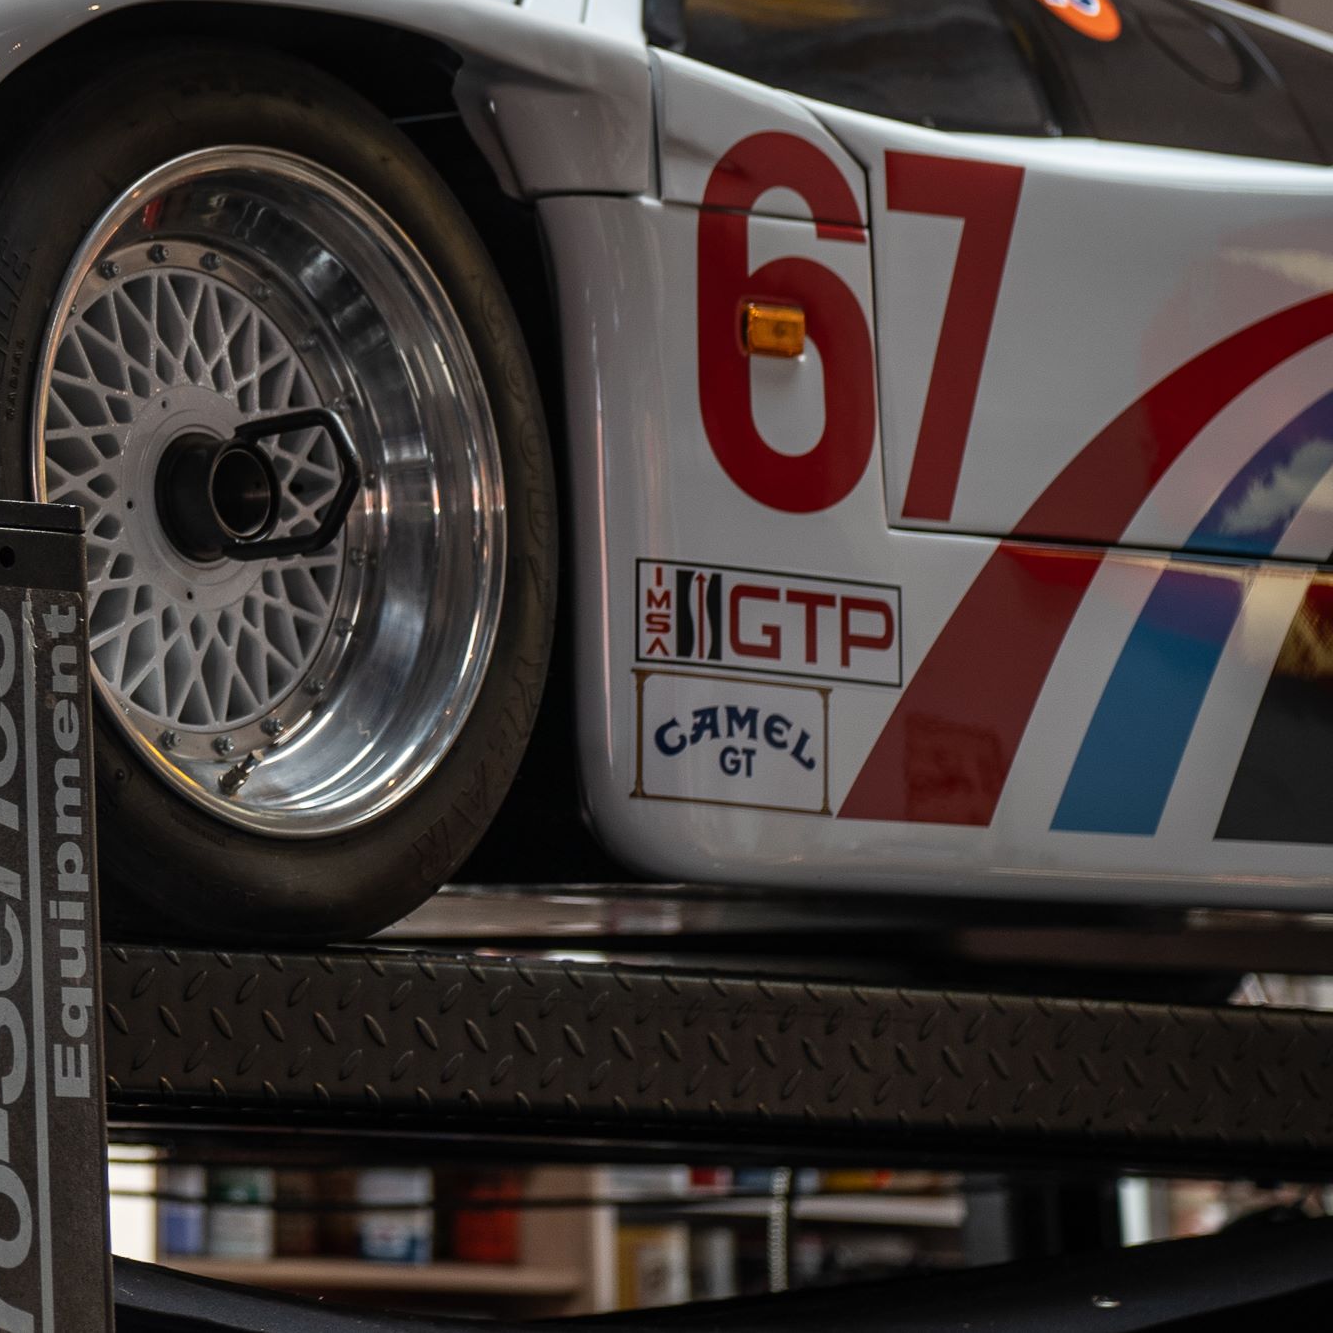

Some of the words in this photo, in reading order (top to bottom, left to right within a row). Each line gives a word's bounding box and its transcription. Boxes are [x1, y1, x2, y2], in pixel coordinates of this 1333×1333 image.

[697, 130, 1025, 522] 67
[729, 584, 894, 667] GTP
[653, 704, 816, 771] CAMEL
[719, 746, 757, 778] GT
[38, 603, 92, 1099] Equipment
